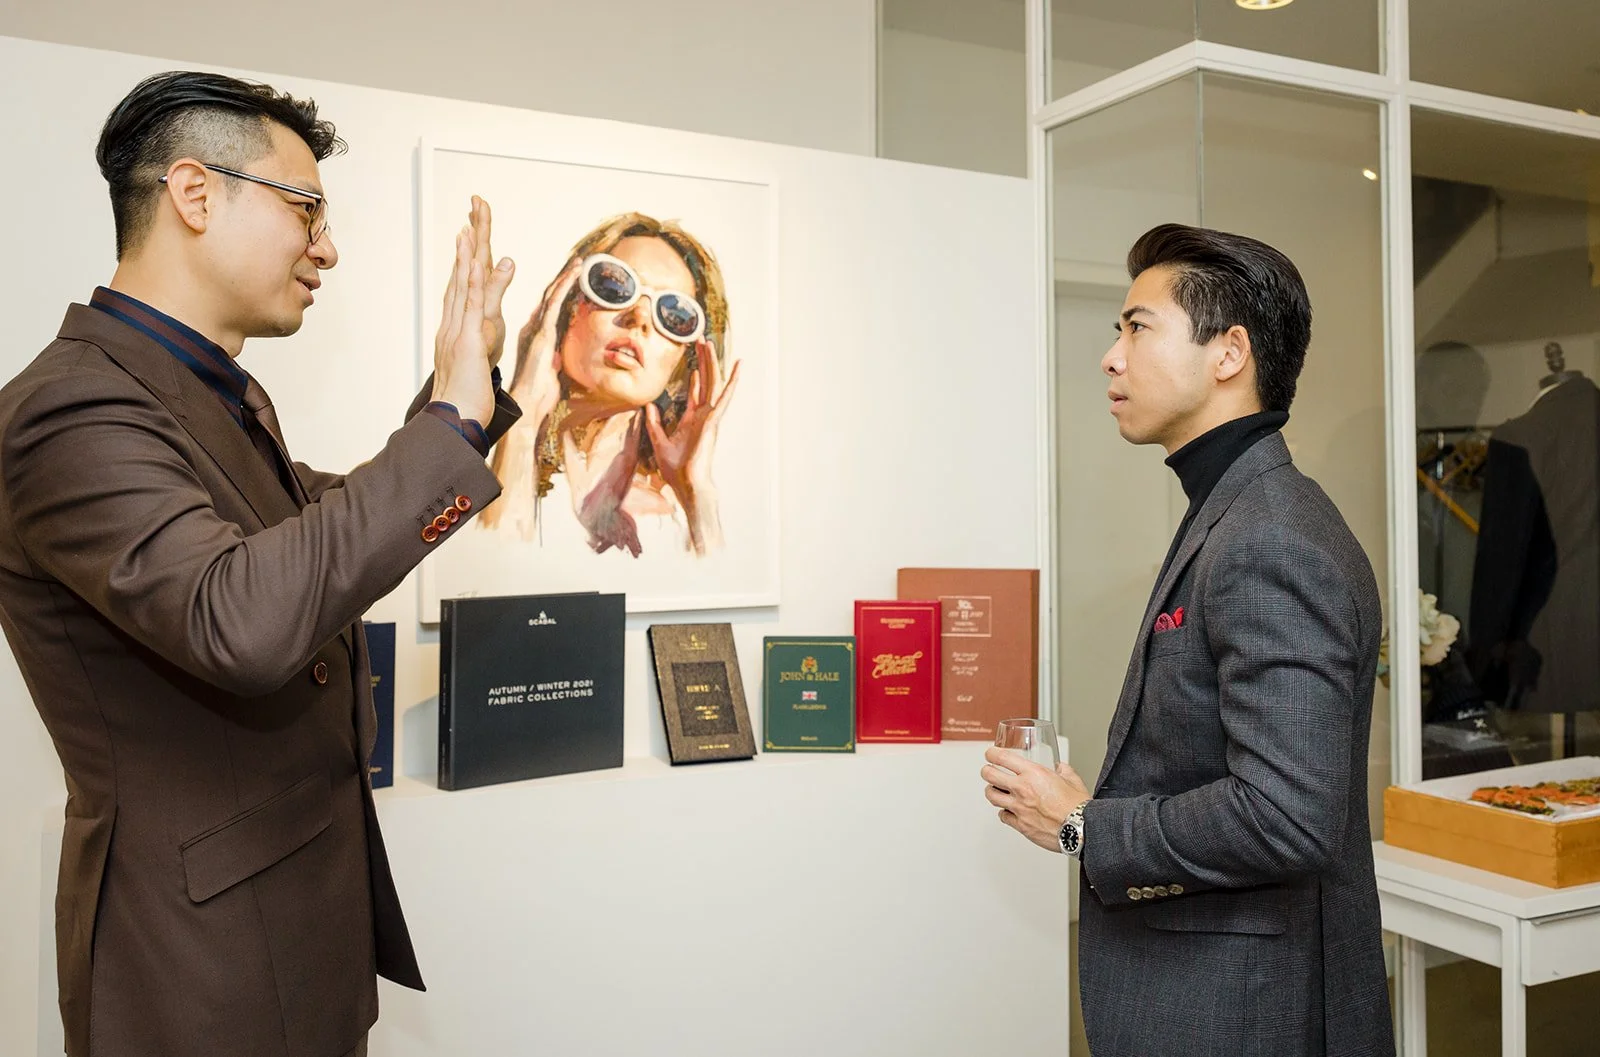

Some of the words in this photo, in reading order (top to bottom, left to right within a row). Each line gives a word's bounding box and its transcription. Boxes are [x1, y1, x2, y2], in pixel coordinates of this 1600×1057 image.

[528, 618, 557, 626] SCABAL
[780, 672, 805, 682] JOHN
[815, 672, 839, 681] HALE
[488, 685, 527, 696] AUTUMN
[536, 680, 571, 692] WINTER
[572, 679, 594, 689] 2021
[487, 695, 524, 706] FABRIC
[527, 688, 594, 703] COLLECTIONS
